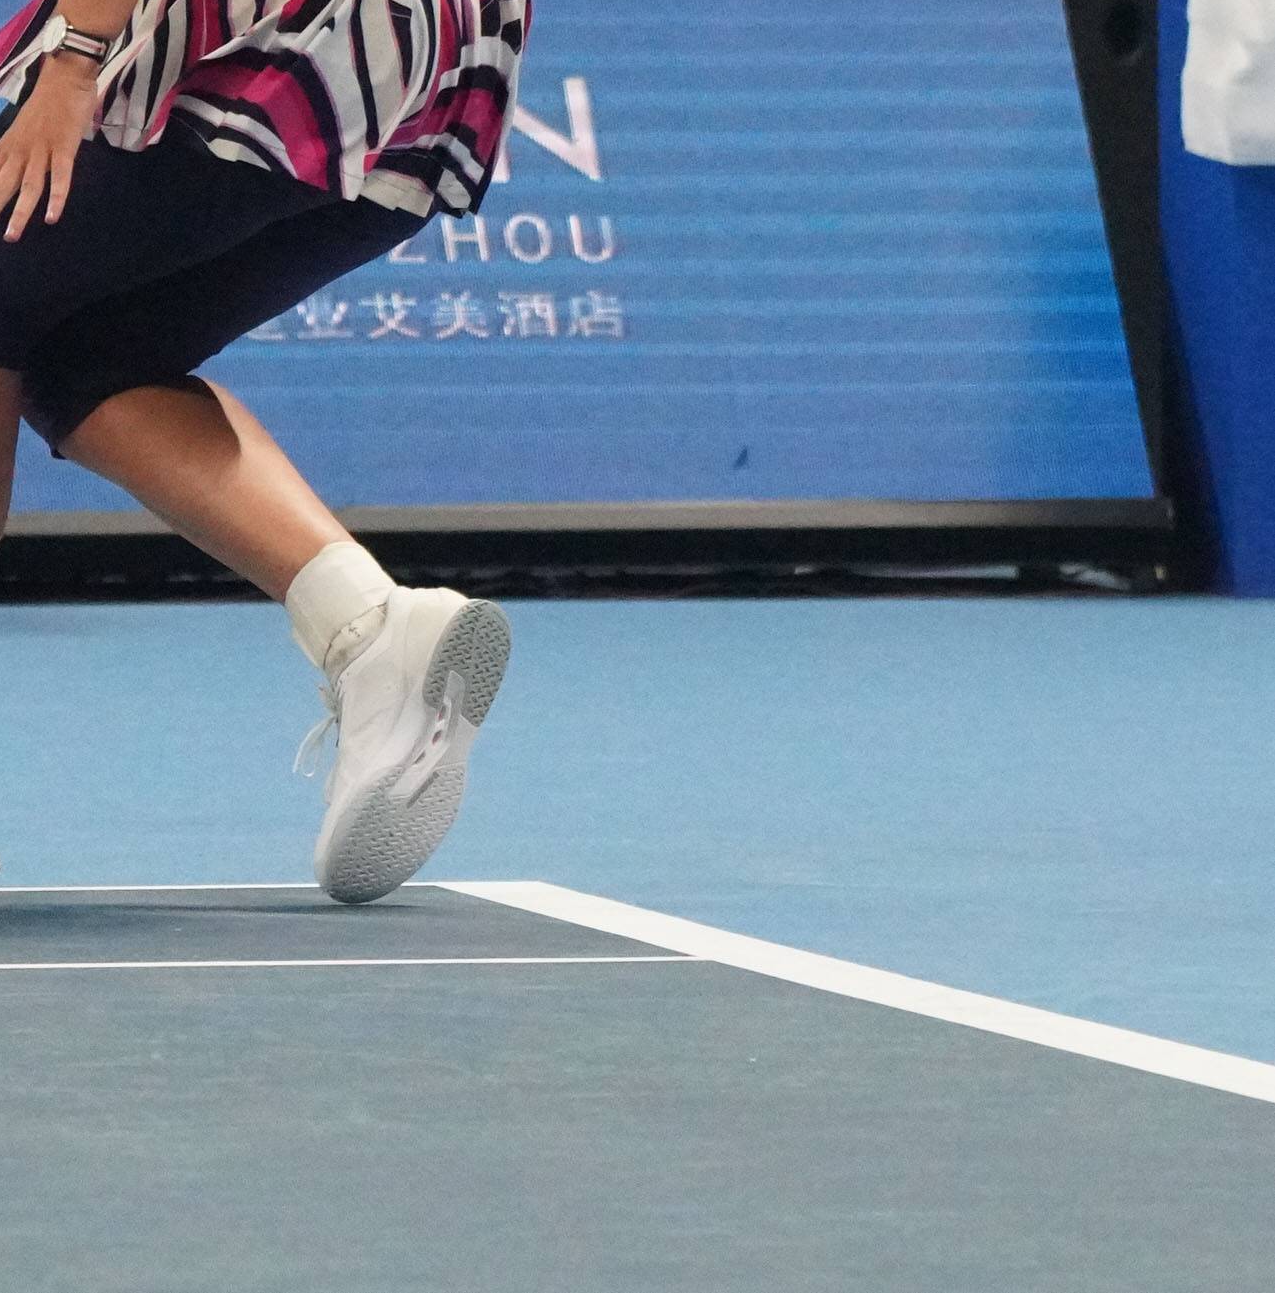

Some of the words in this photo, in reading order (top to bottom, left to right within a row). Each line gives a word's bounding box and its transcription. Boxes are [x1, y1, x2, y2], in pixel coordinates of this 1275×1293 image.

[247, 289, 625, 340] 业艾美酒店
